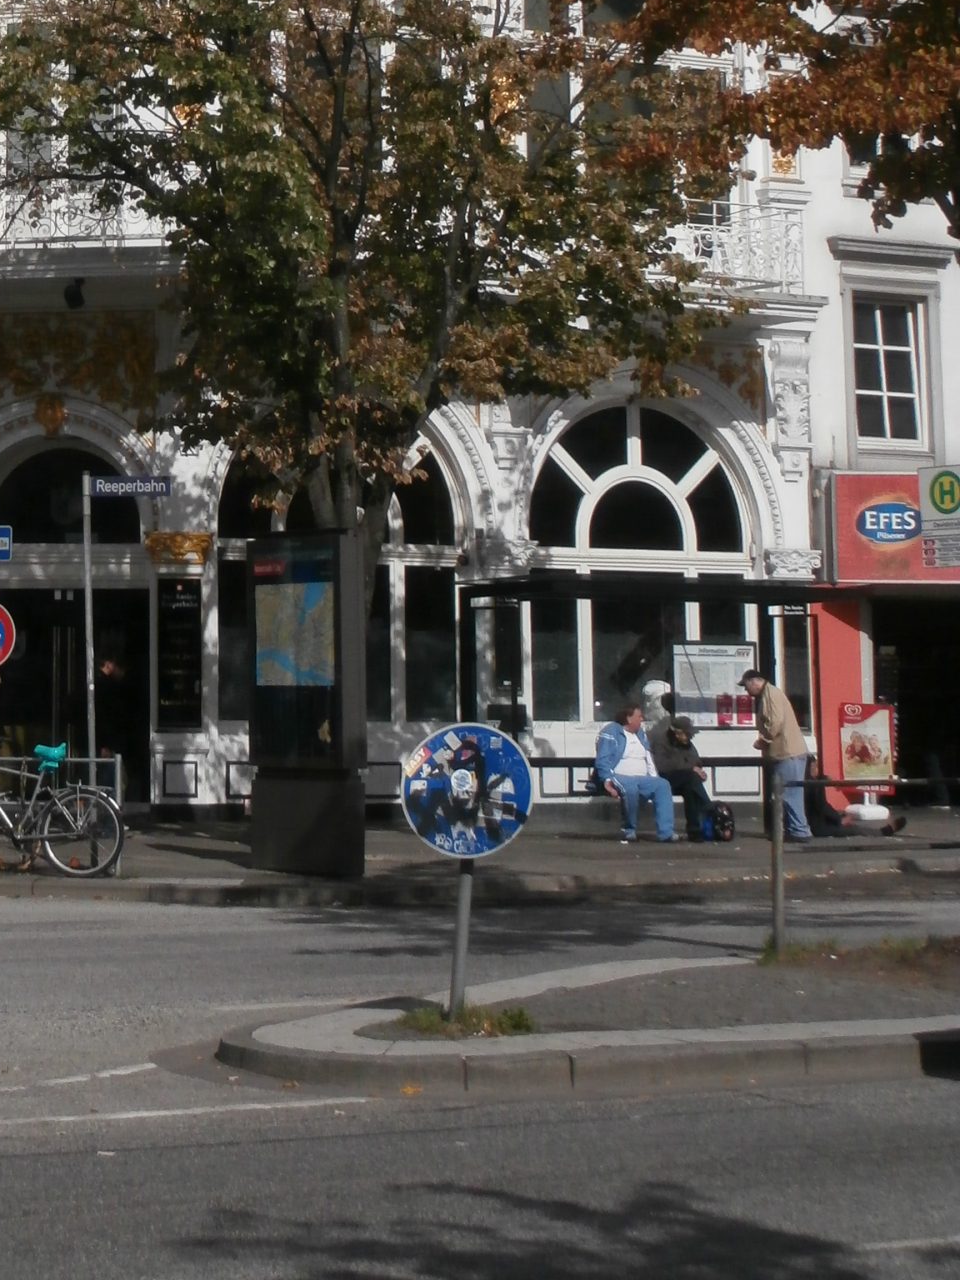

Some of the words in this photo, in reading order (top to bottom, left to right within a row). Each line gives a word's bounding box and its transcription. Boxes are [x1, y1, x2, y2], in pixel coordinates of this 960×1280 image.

[96, 479, 167, 495] Reeperbahn
[939, 480, 956, 505] H
[864, 510, 917, 530] EFES
[876, 531, 906, 540] Pilsener
[404, 748, 427, 776] EASY
